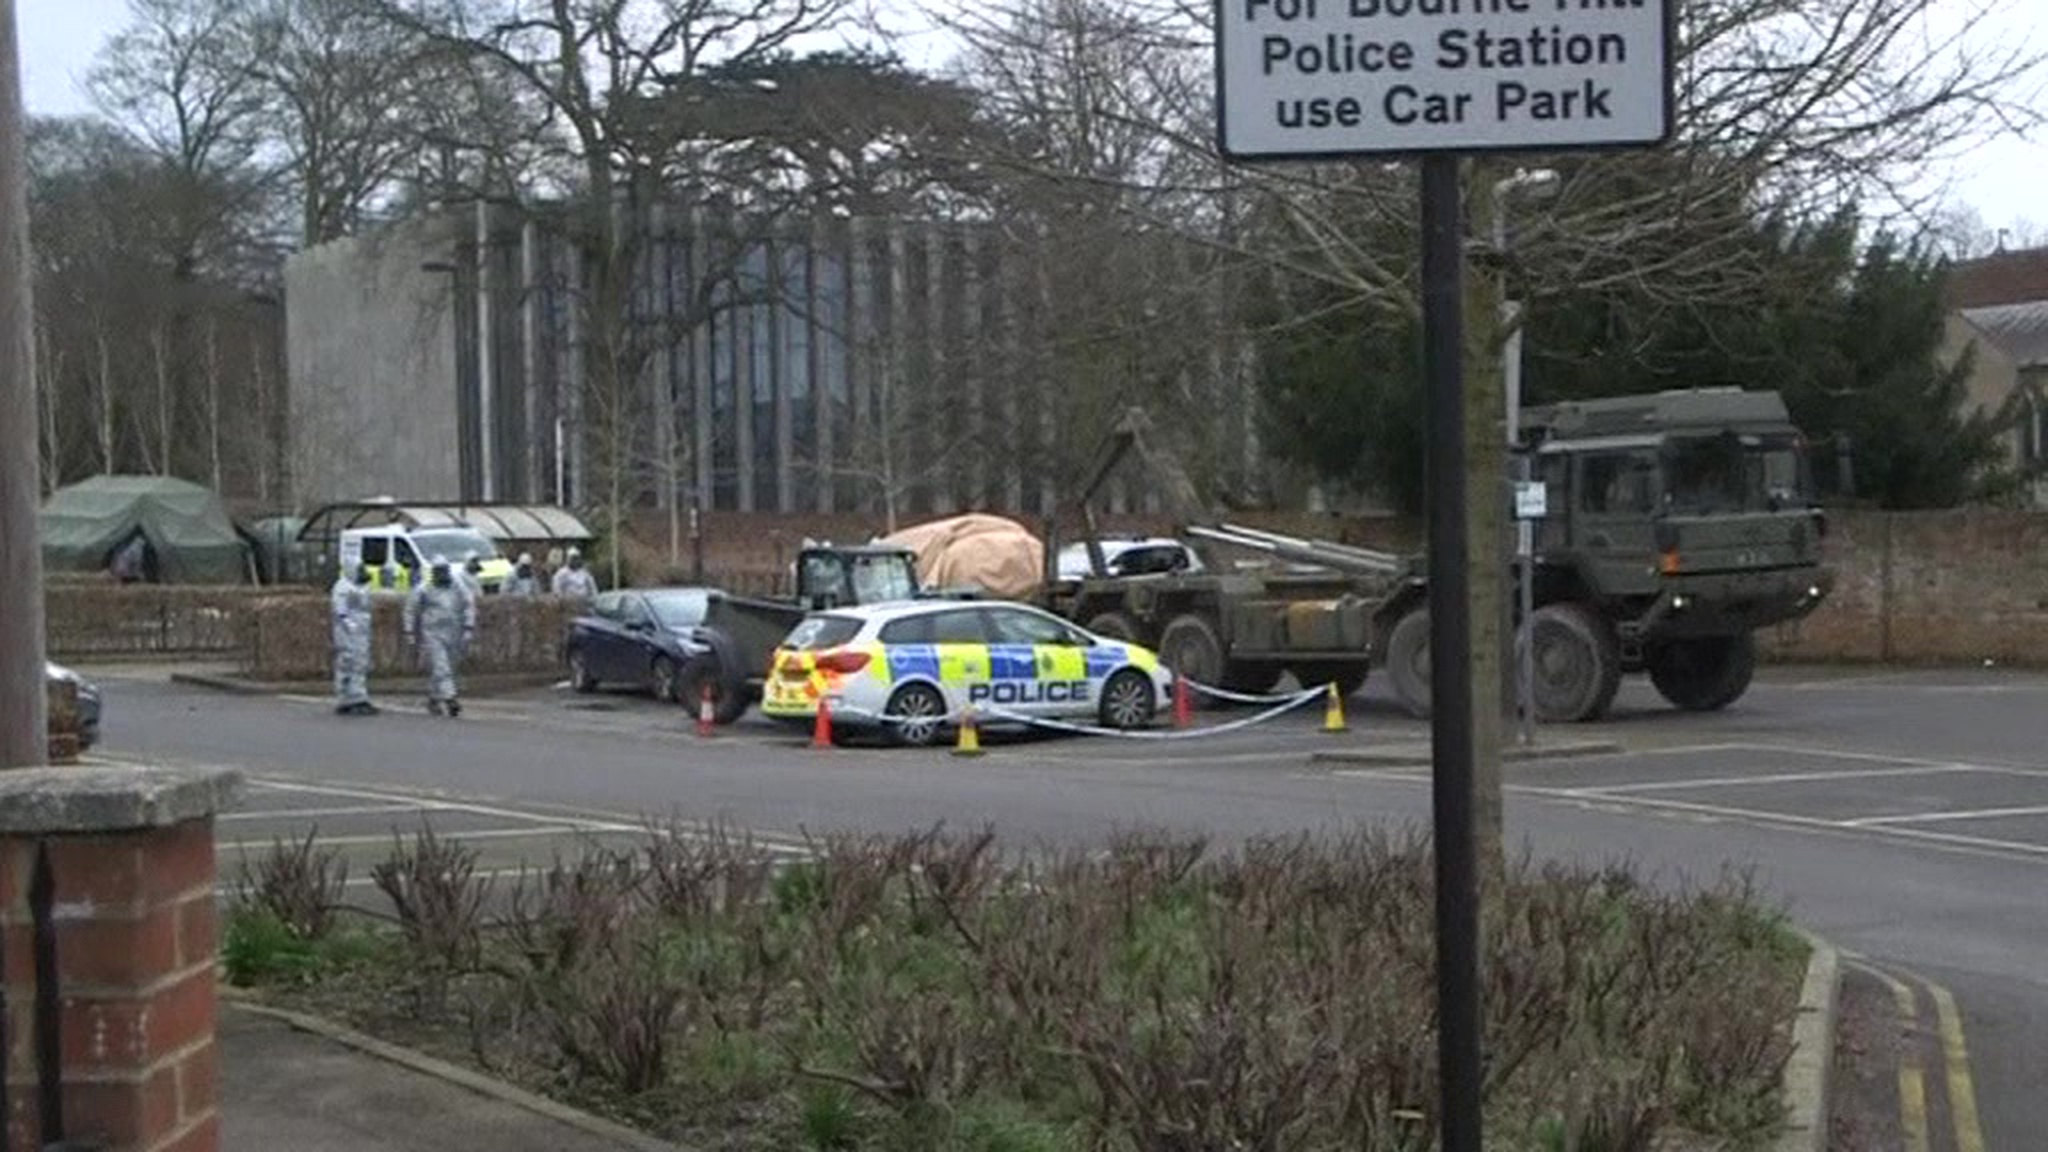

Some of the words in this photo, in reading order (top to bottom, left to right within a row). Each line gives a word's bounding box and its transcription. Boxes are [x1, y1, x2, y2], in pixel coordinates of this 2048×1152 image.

[1262, 34, 1414, 75] Police
[1436, 26, 1626, 69] Station
[1276, 97, 1362, 128] use
[1383, 84, 1472, 123] Car
[1498, 79, 1612, 120] Park
[970, 681, 1089, 704] POLICE
